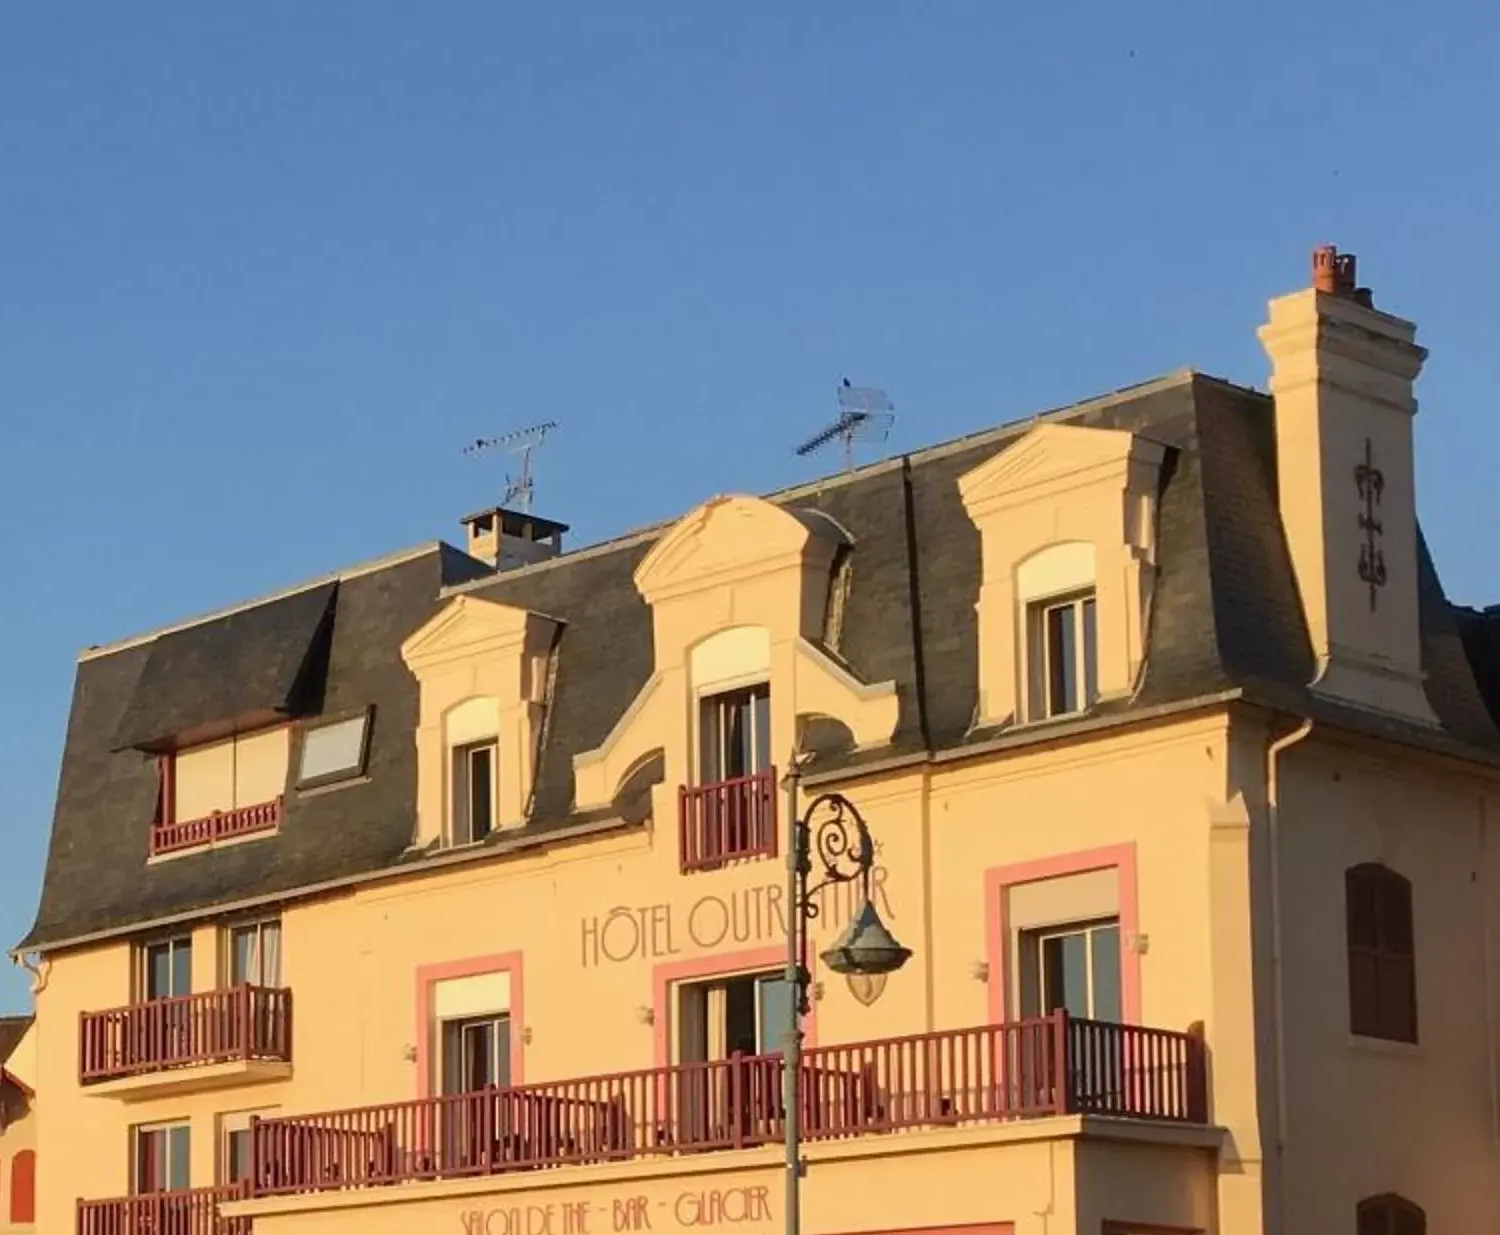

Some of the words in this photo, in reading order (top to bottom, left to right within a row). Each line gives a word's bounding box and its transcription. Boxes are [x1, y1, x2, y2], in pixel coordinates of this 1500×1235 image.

[581, 904, 681, 968] HÔTEL
[611, 1195, 652, 1233] BAR
[674, 1186, 773, 1228] GLACIER
